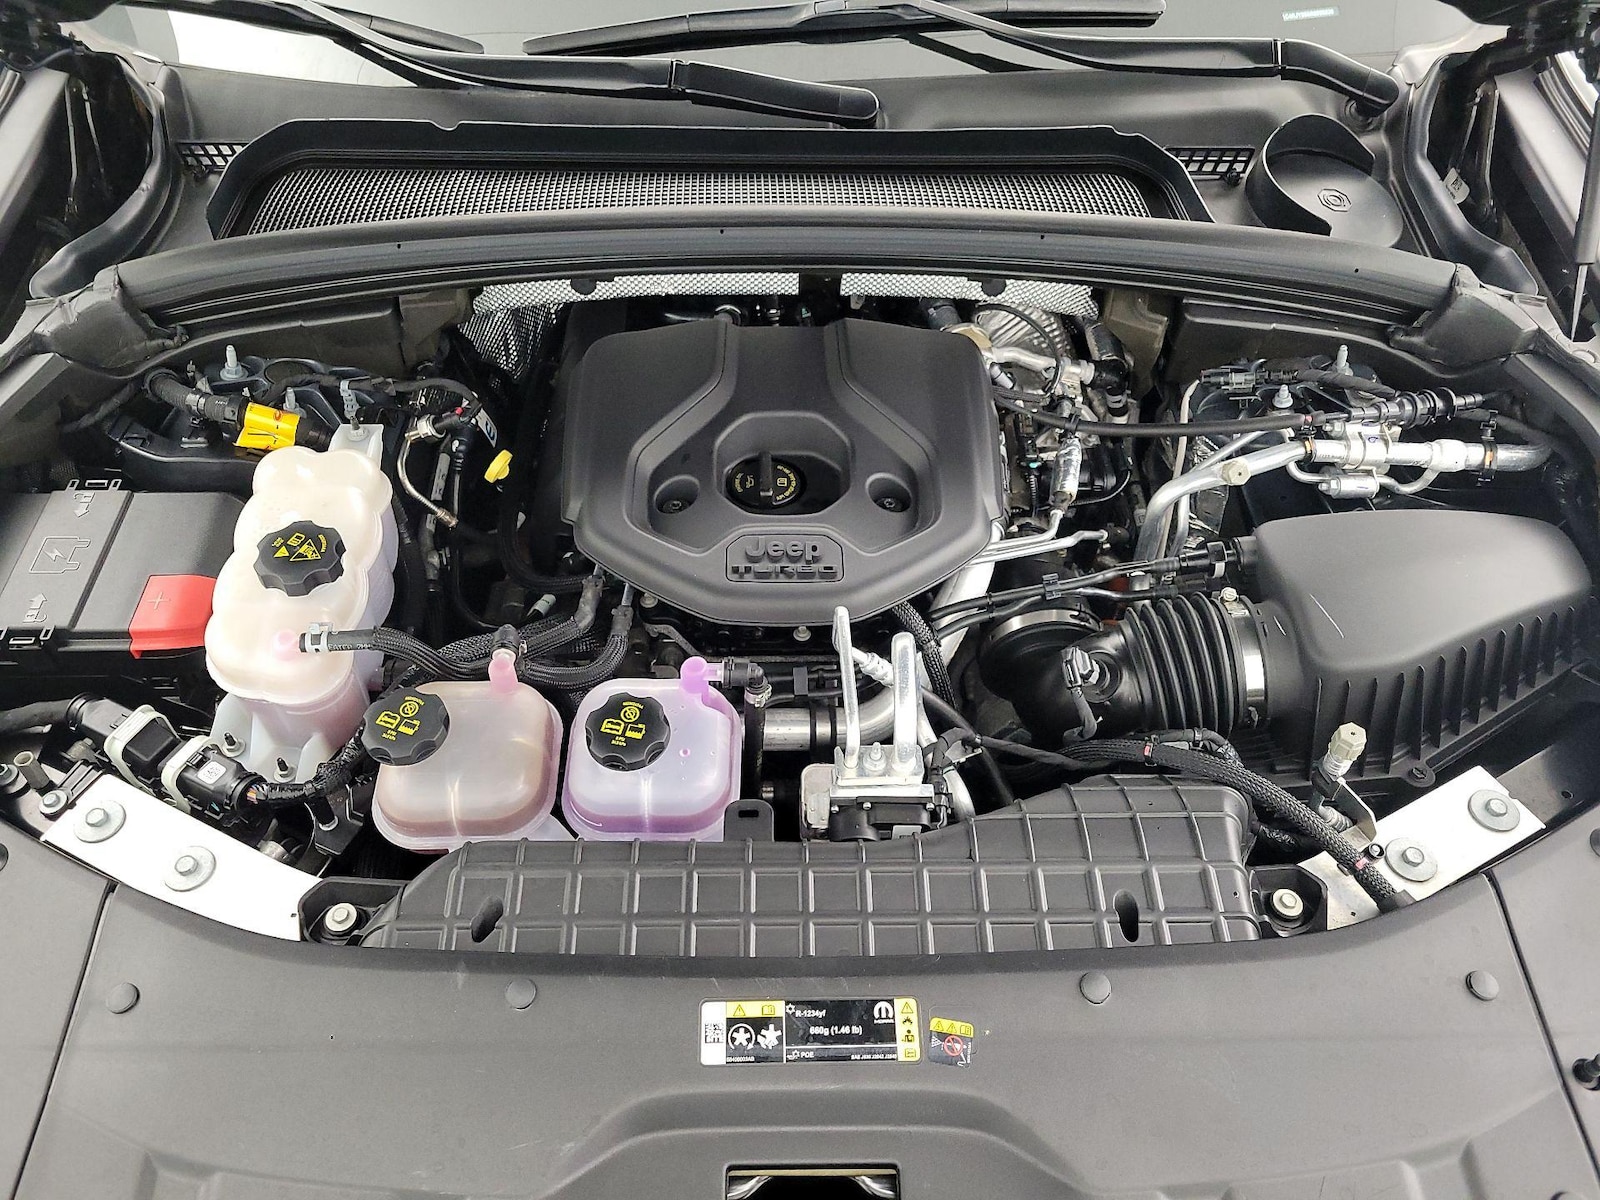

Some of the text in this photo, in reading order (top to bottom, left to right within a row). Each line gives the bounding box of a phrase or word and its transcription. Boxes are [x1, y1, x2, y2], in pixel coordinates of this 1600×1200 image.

[745, 537, 822, 564] Jeep
[731, 564, 838, 579] TURBO
[795, 1009, 827, 1019] R-1234yf
